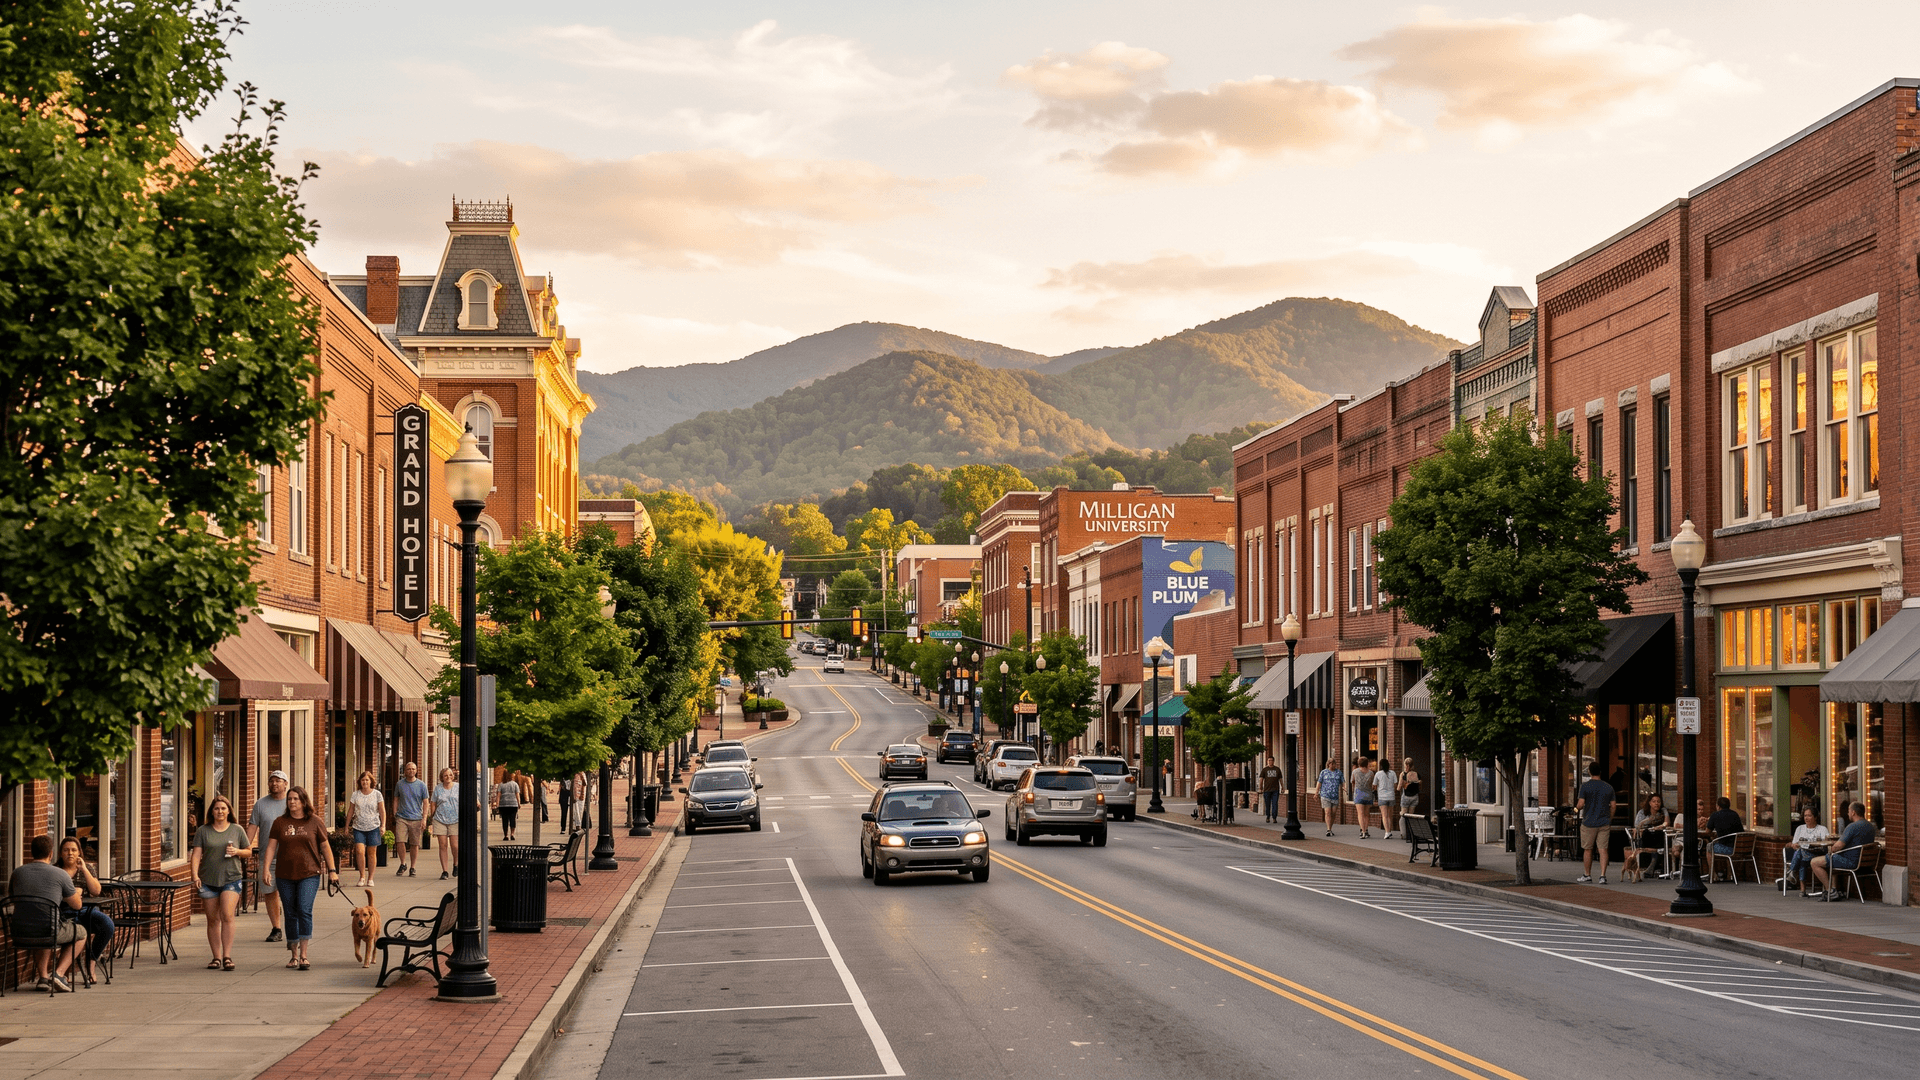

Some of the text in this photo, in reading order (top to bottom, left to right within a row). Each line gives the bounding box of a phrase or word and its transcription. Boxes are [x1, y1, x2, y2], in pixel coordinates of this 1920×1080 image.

[402, 415, 421, 609] GRAND HOTEL
[1079, 501, 1175, 519] MILLIGAN
[1085, 520, 1169, 532] UNIVERSITY
[1167, 576, 1209, 590] BLUE
[1152, 591, 1198, 604] PLUM
